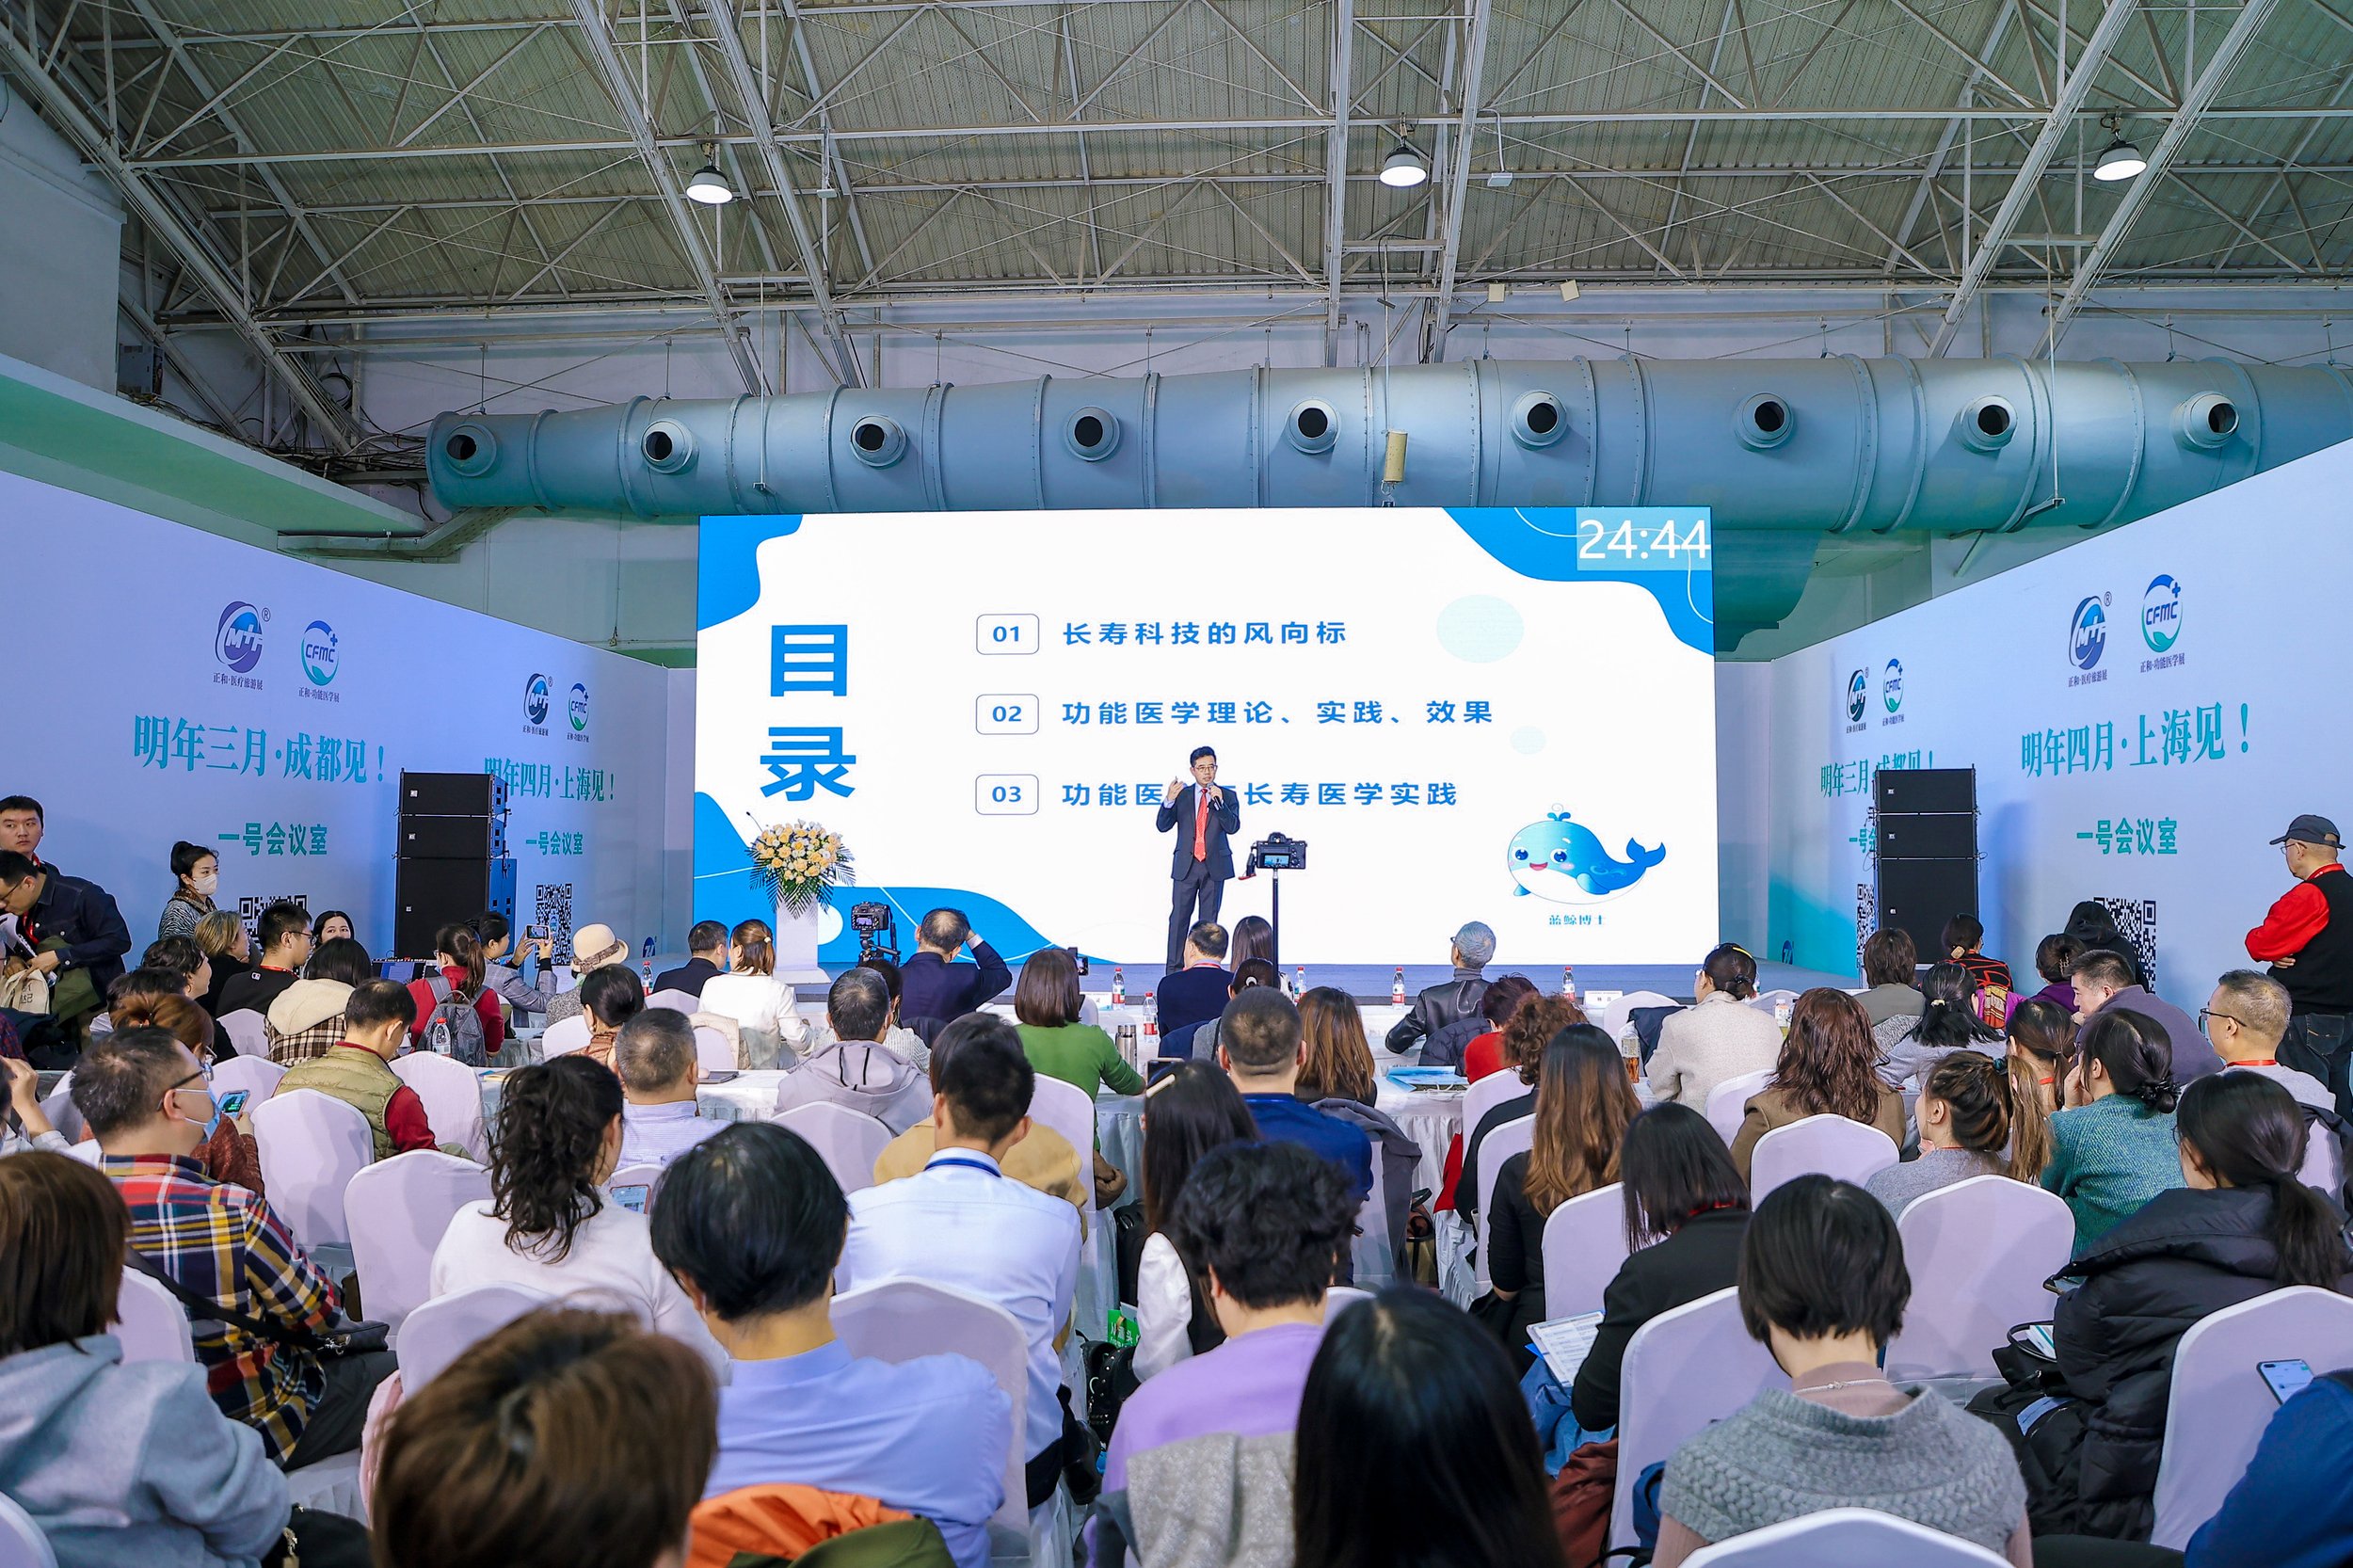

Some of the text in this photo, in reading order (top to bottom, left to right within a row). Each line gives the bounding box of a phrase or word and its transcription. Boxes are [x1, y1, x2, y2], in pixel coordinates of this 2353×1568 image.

[1578, 519, 1711, 560] 24:44
[2146, 601, 2178, 625] CFMC
[992, 621, 1347, 646] 01 长寿科技的风向标
[305, 643, 336, 664] CFMC
[760, 624, 856, 802] 目录
[992, 700, 1494, 725] 02 功能医学理论、实践、效果
[134, 715, 384, 784] 明年三月·成都见！
[2022, 702, 2249, 778] 明年四月·上海见！
[992, 782, 1458, 807] 03 功能医长寿医学实践
[217, 822, 328, 856] 一号会议室
[525, 830, 584, 856] 一号会议室
[2076, 817, 2178, 856] 一号会议室
